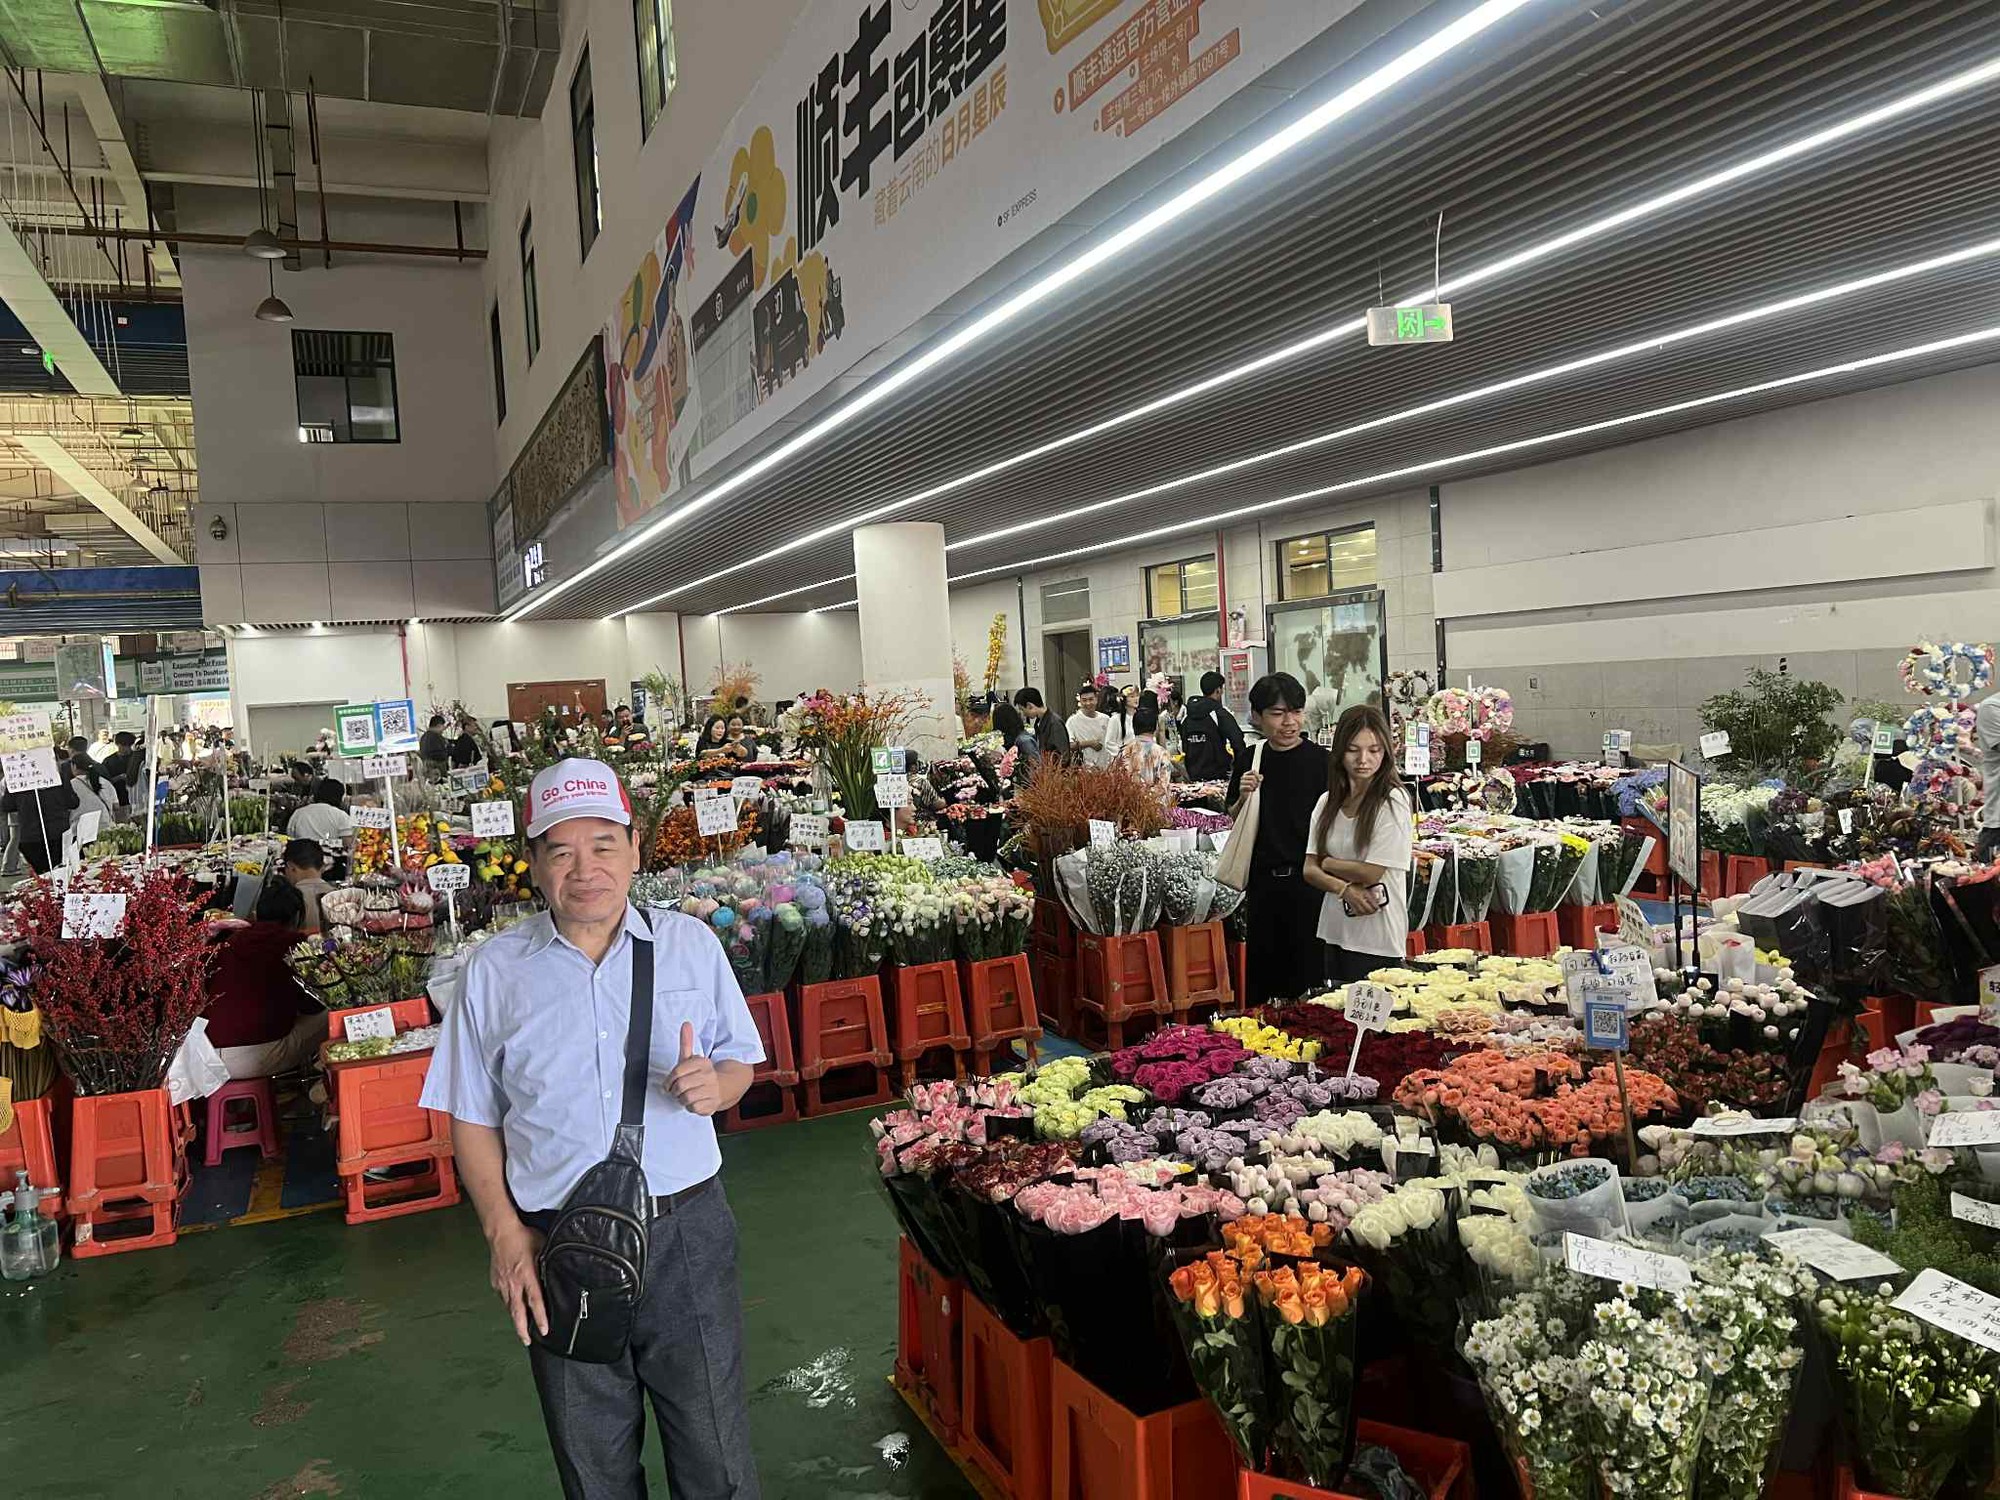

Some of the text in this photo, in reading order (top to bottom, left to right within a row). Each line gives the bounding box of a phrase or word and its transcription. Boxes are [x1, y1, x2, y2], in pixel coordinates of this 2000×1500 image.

[1073, 0, 1198, 100] 顺丰速运官方营业
[1011, 190, 1036, 217] EXPRESS
[541, 779, 607, 802] Go China
